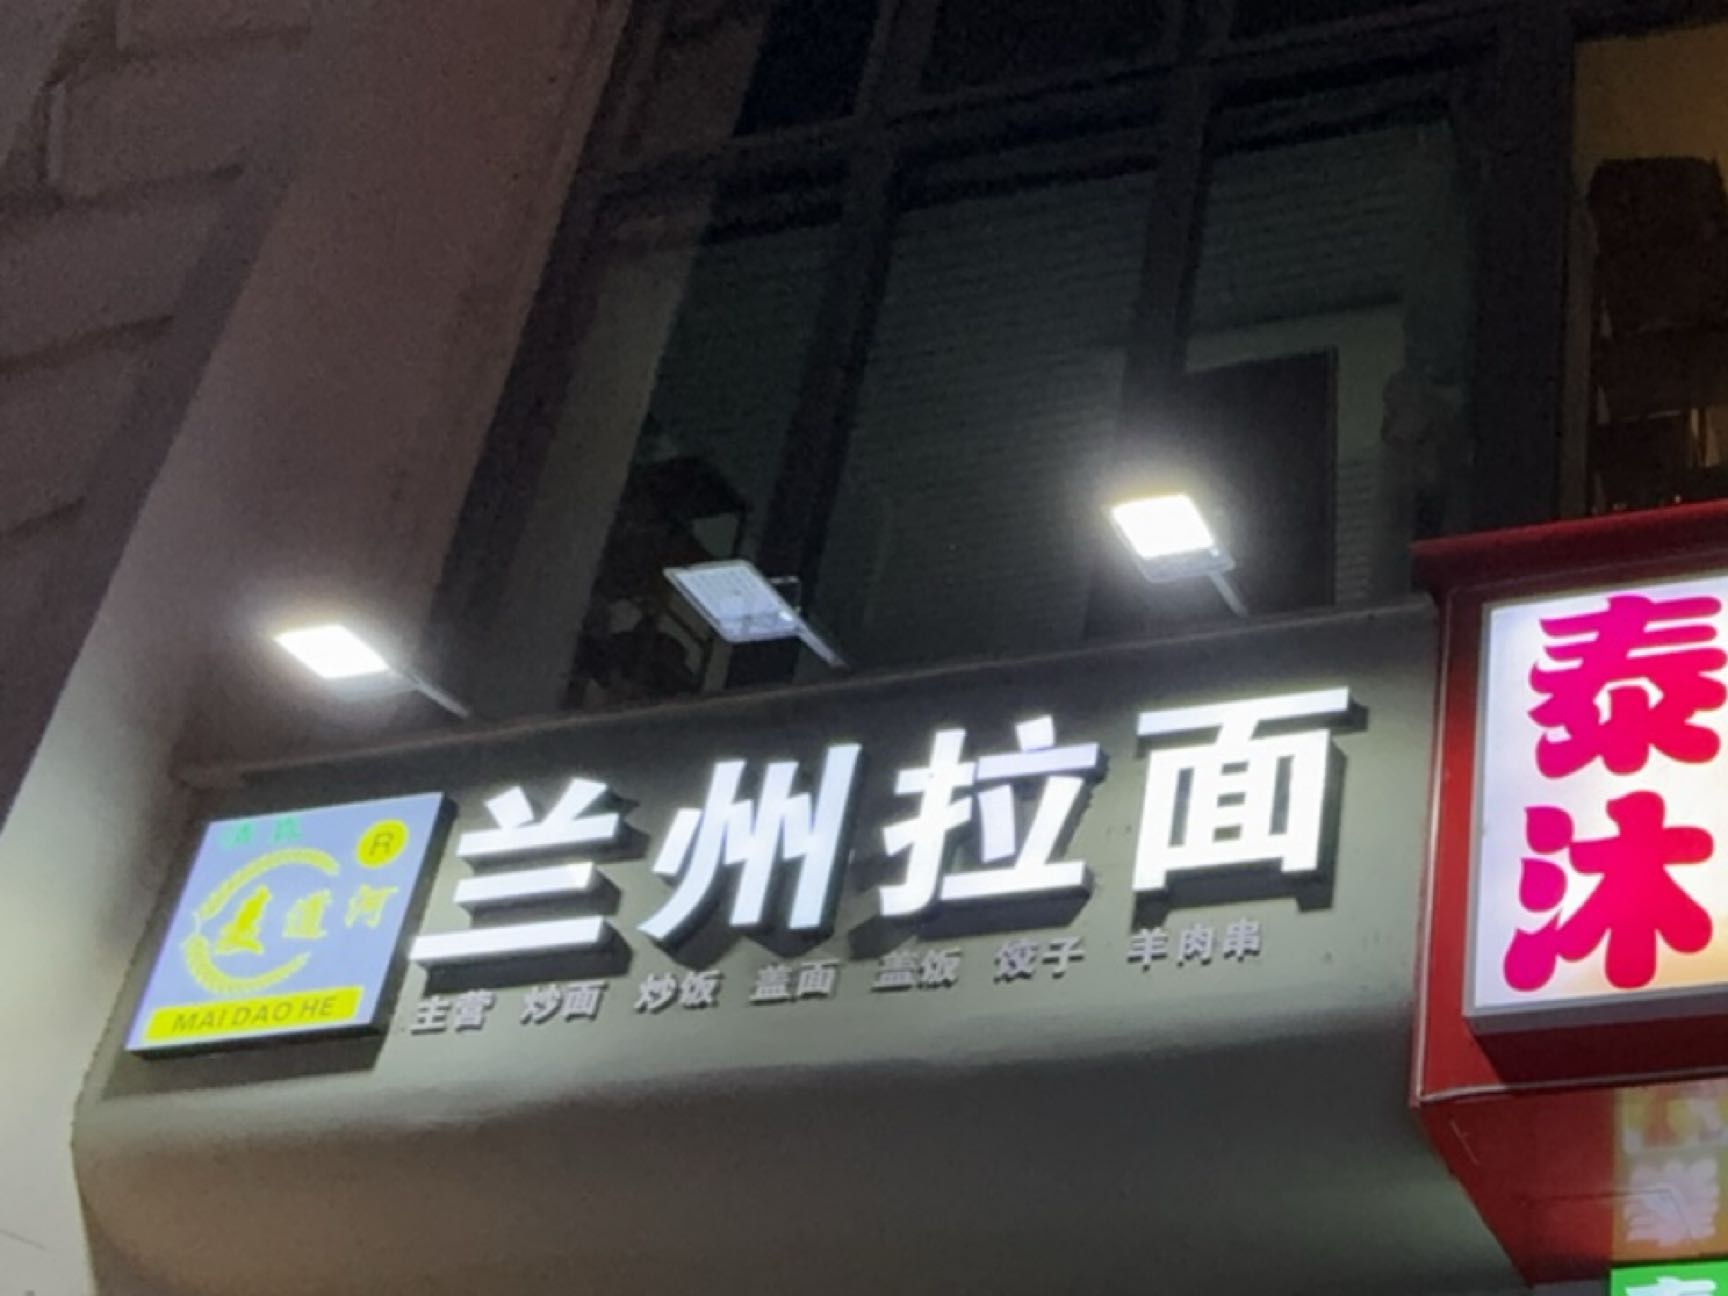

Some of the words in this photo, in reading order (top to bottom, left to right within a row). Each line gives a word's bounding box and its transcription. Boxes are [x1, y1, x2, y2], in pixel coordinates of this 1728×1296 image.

[410, 686, 1350, 960] 兰州拉面
[1504, 595, 1728, 991] 泰沐
[297, 995, 338, 1018] HE
[411, 990, 495, 1033] 主营
[520, 980, 605, 1025] 炒面
[634, 971, 720, 1012] 炒饭
[751, 962, 839, 1002] 盖面
[872, 947, 962, 990] 盖饭
[994, 936, 1084, 981] 饺子
[1128, 918, 1261, 968] 羊肉串
